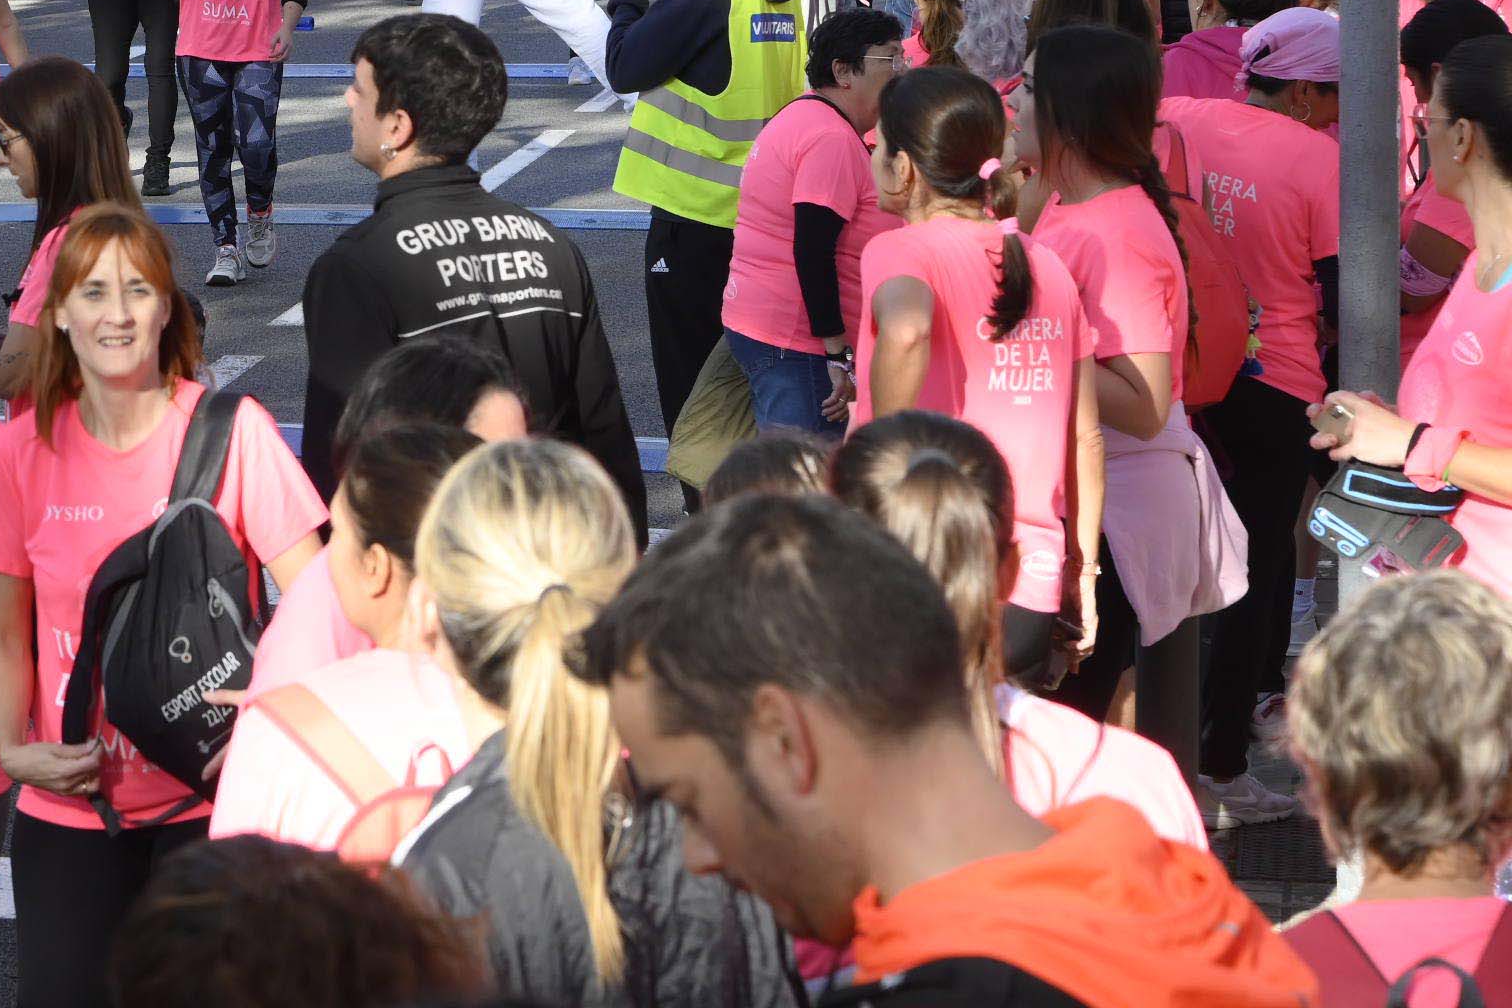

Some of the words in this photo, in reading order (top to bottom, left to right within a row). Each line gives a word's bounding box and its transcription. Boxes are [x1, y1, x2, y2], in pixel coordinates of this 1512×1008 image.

[202, 1, 249, 20] SUMA
[396, 218, 471, 256] GRUP
[471, 214, 555, 243] BARNA
[436, 250, 549, 288] PORTERS
[994, 342, 1022, 364] DE
[1028, 339, 1052, 363] LA
[987, 362, 1055, 393] MUJER
[161, 685, 205, 724] ESPORT
[200, 651, 242, 699] ESCOLAR
